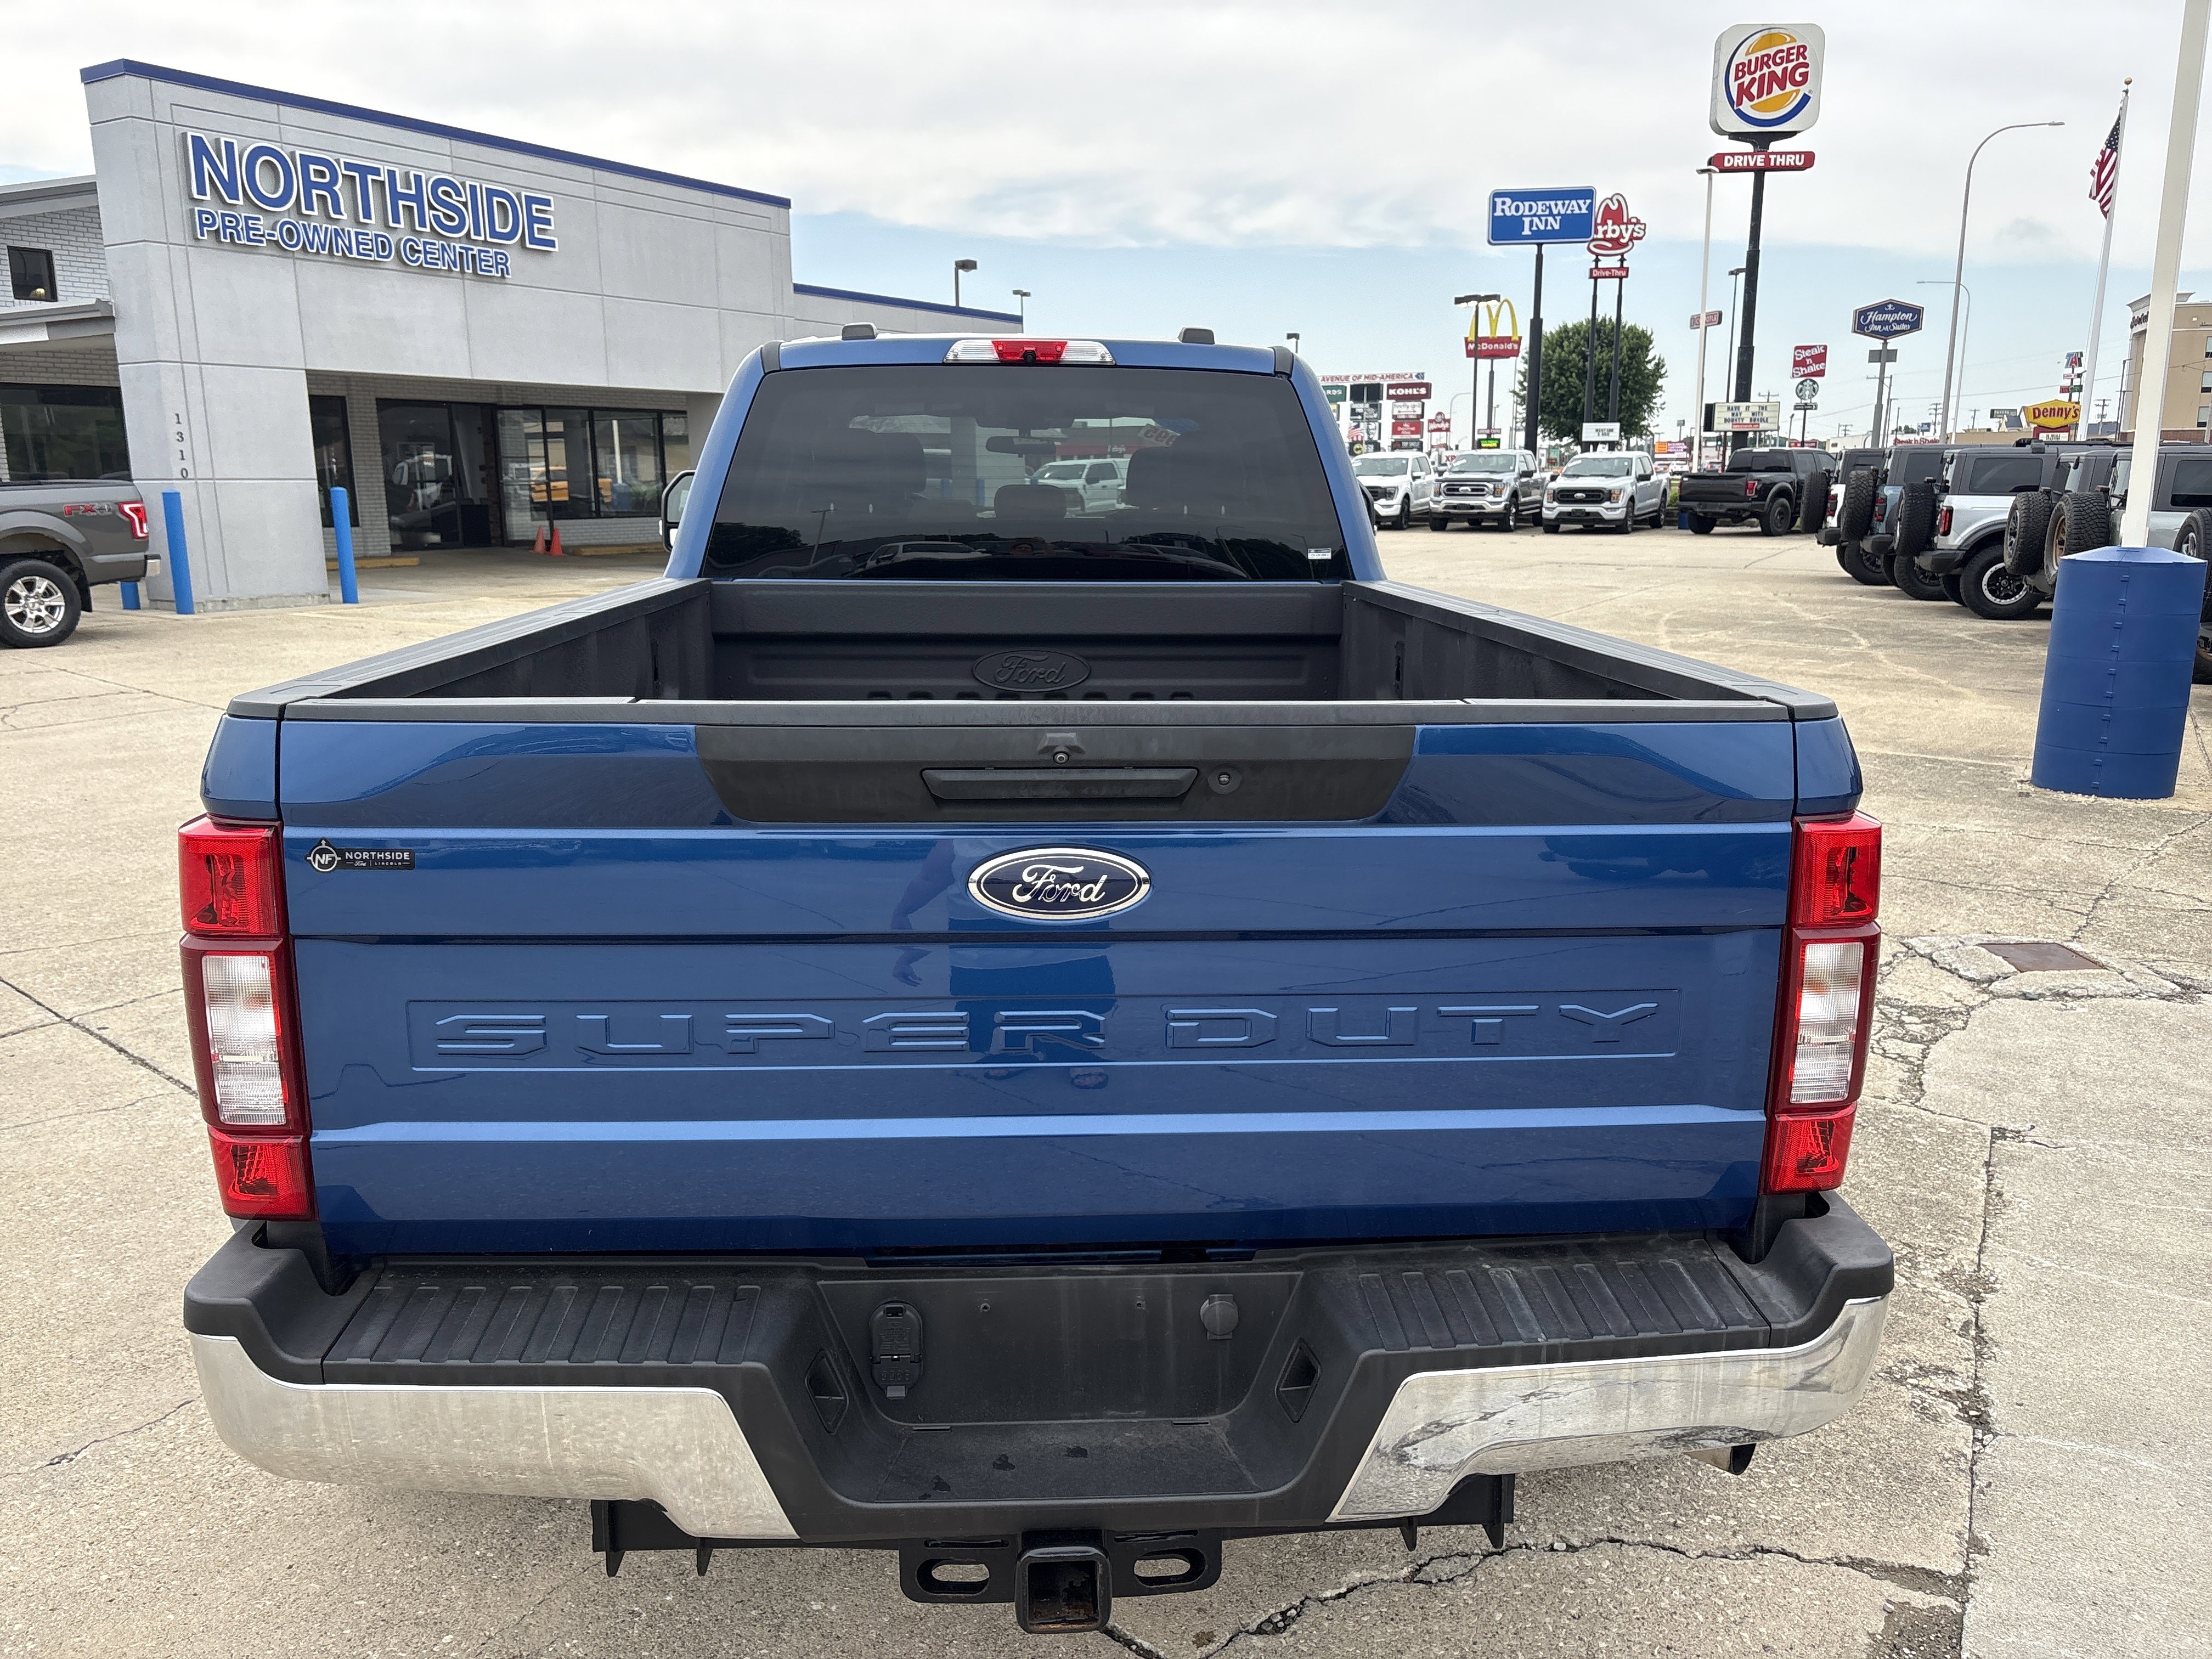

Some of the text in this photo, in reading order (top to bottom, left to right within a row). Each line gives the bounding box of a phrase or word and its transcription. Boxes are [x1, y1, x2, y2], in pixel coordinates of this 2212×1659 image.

[1735, 44, 1808, 82] BURGER
[1736, 61, 1810, 108] KING
[1724, 154, 1805, 167] DRIVE THRU
[185, 132, 559, 252] NORTHSIDE
[1521, 216, 1562, 236] INN
[1594, 218, 1645, 244] rby's
[194, 208, 512, 279] PRE-OWNED CENTER
[1860, 310, 1918, 325] Hampton
[1864, 324, 1883, 332] Inn
[1795, 345, 1825, 361] Steak
[1792, 362, 1826, 377] Shake
[1321, 374, 1350, 383] AVENUE
[1363, 373, 1414, 381] MID-AMERICA
[1388, 387, 1427, 396] KOHL'S
[2032, 405, 2080, 420] Denny's
[64, 504, 112, 516] FX4
[995, 653, 1068, 684] Ford
[345, 851, 410, 860] NORTHSIDE
[1012, 864, 1109, 903] Ford
[434, 1002, 1659, 1056] SUPER DUTY
